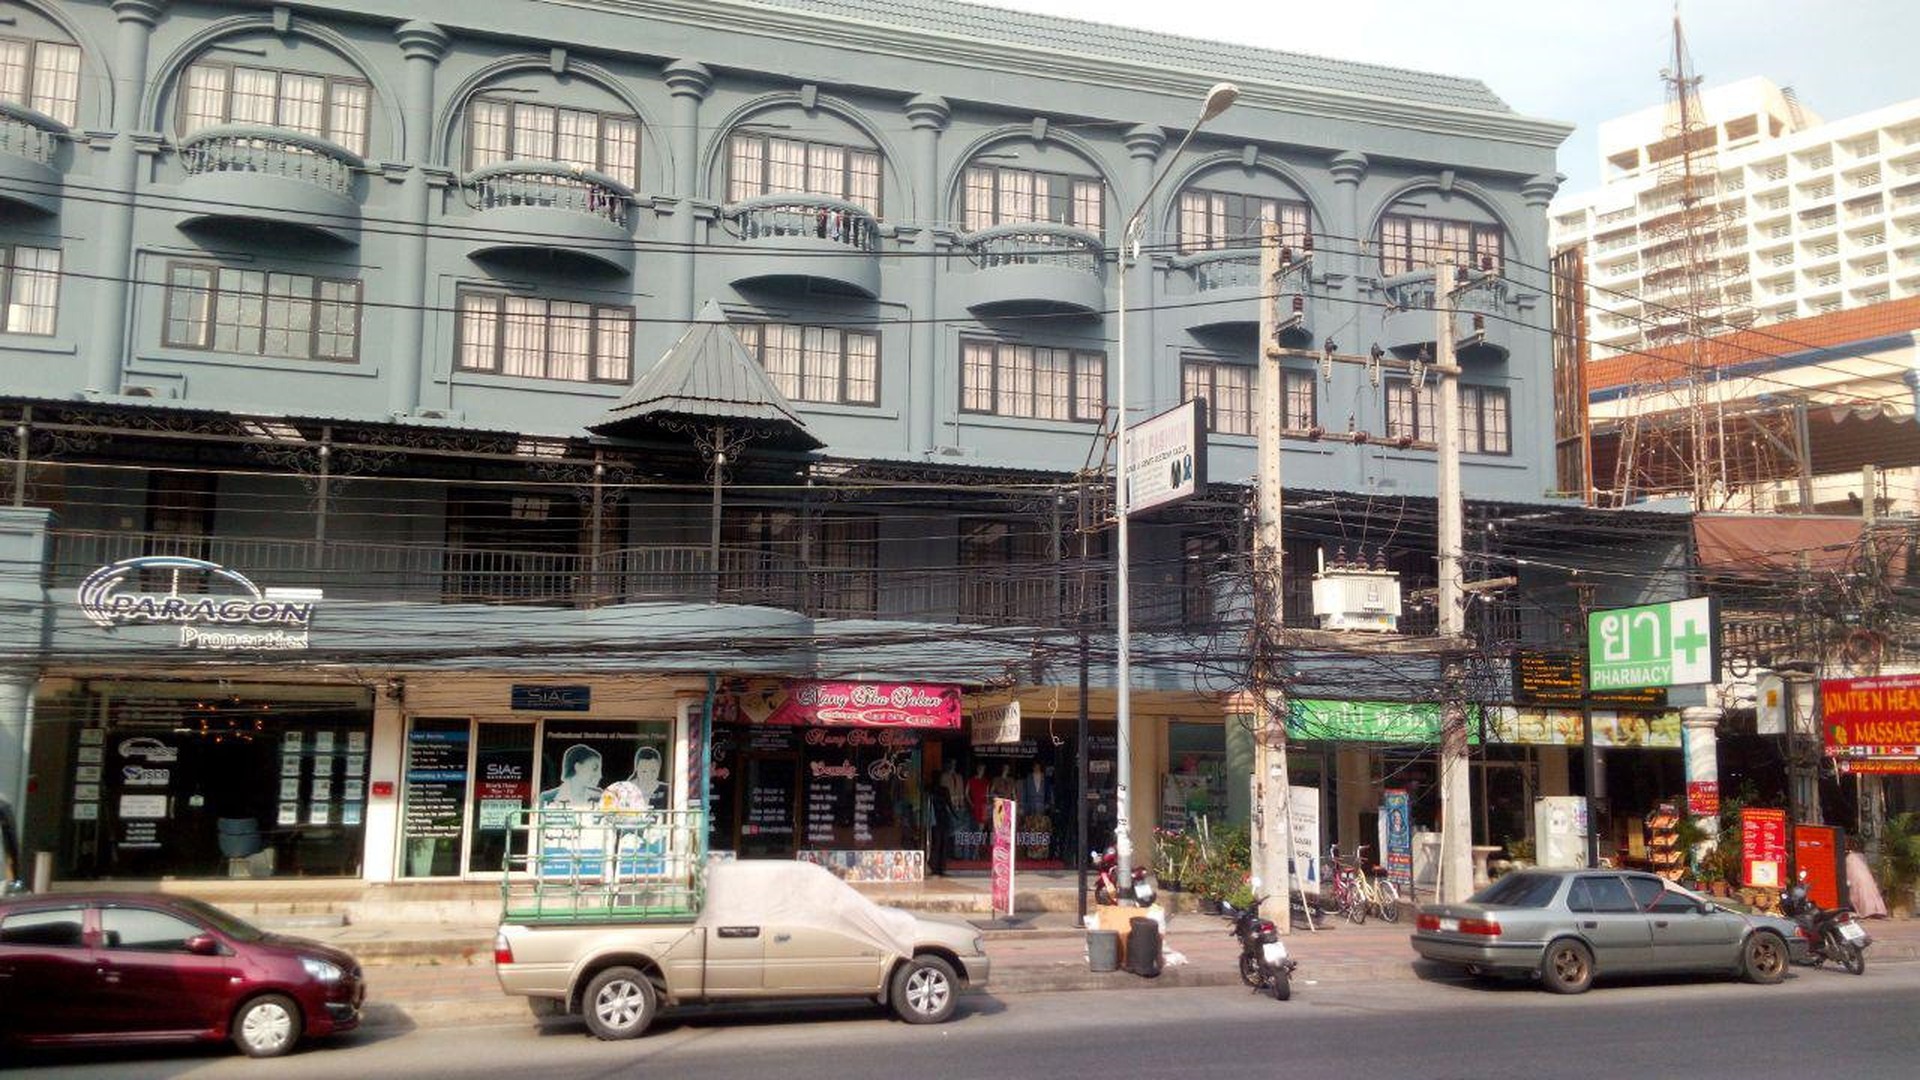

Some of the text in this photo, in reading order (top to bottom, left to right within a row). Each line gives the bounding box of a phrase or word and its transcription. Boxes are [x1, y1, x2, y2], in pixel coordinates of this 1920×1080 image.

[109, 595, 314, 622] PARAGON
[181, 626, 308, 649] Properties
[1600, 611, 1662, 661] ยา
[1593, 666, 1671, 686] PHARMACY
[1824, 688, 1920, 716] JOMTIEN HEA
[1855, 721, 1920, 743] MASSAGE
